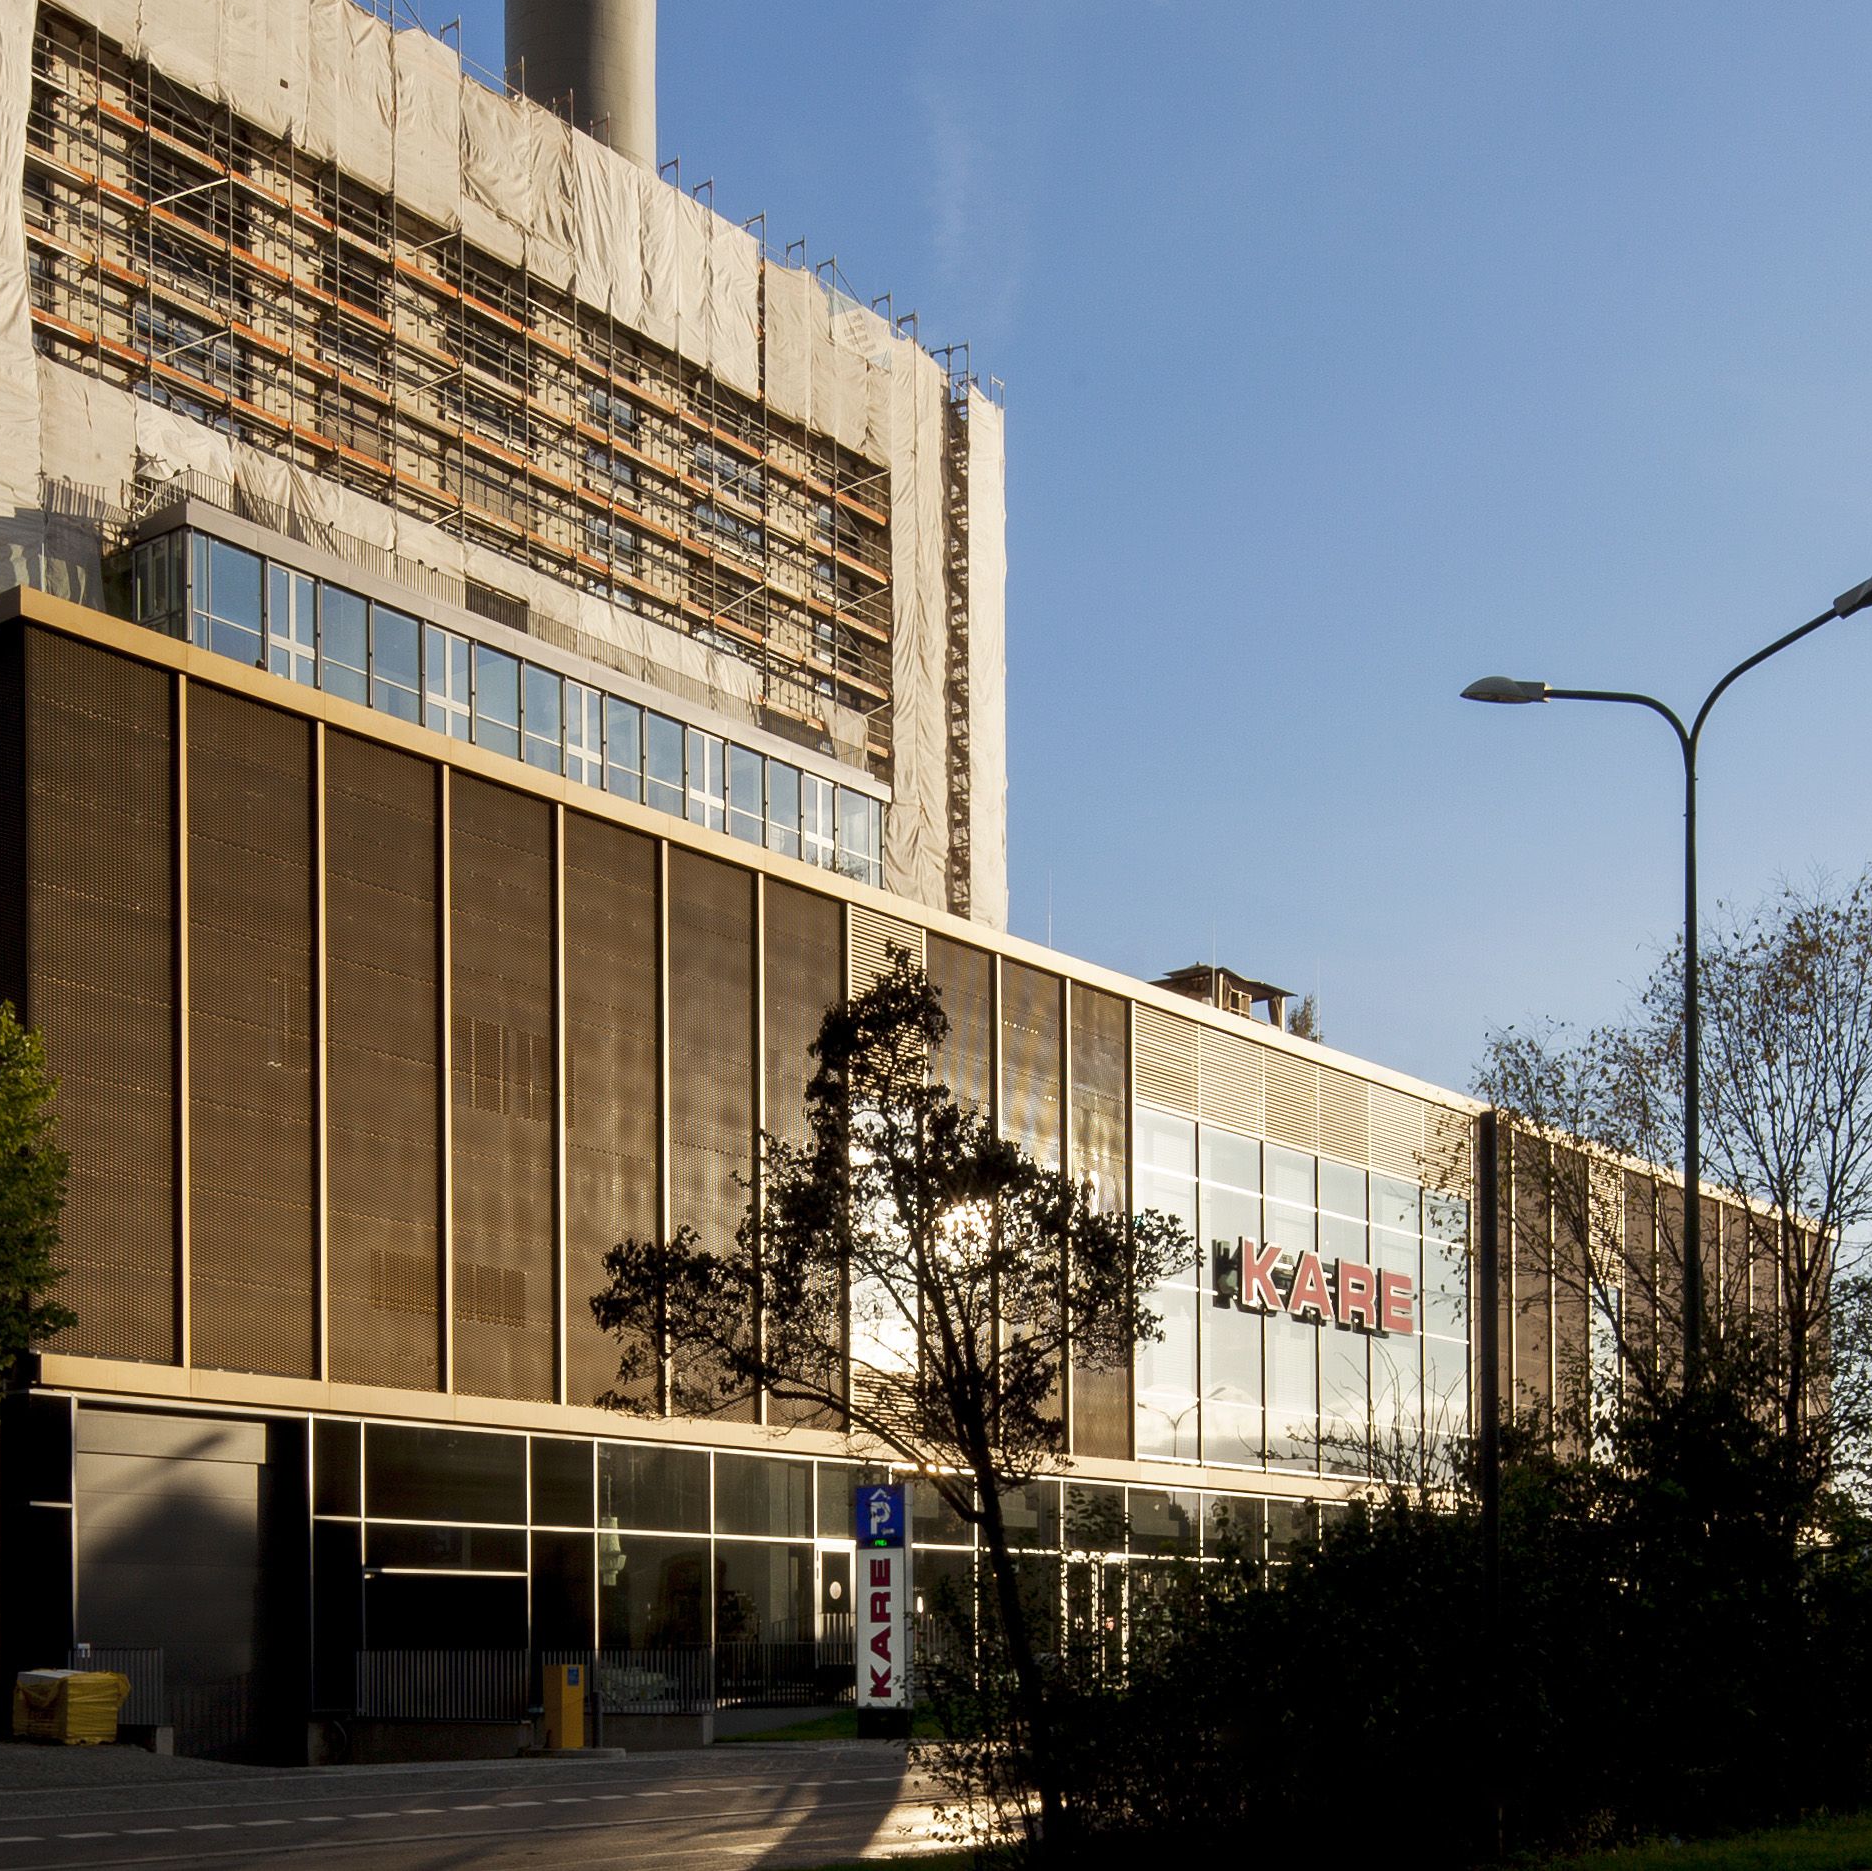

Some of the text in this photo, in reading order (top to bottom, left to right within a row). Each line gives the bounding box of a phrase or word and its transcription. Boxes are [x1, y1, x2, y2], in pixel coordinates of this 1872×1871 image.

[1239, 1235, 1414, 1335] KARE
[870, 1501, 891, 1535] P
[870, 1558, 892, 1698] KARE
